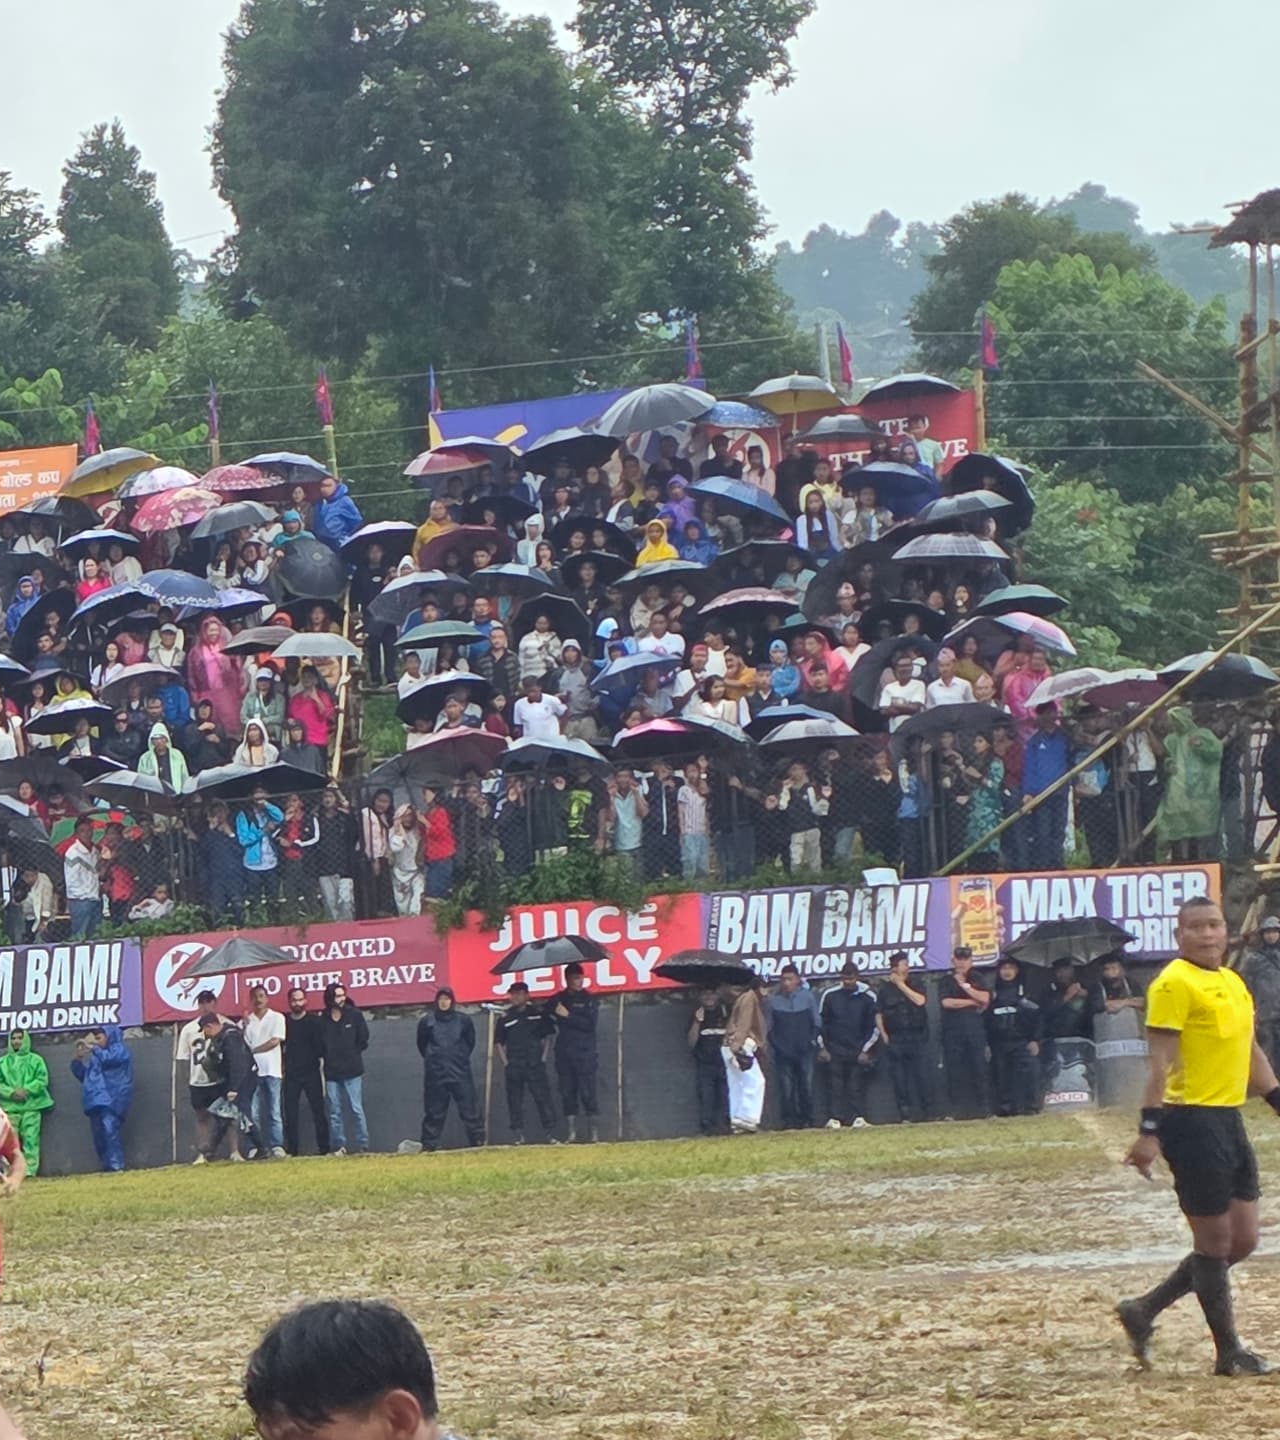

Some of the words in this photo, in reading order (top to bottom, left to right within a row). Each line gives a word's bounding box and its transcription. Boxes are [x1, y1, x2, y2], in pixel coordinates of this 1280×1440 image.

[717, 891, 811, 954] BAM
[821, 884, 929, 949] BAM!
[1012, 877, 1097, 921] MAX
[490, 902, 659, 951] JUICE
[24, 943, 122, 1006] BAM!
[349, 963, 436, 988] BRAVE
[52, 1004, 120, 1027] DRINK
